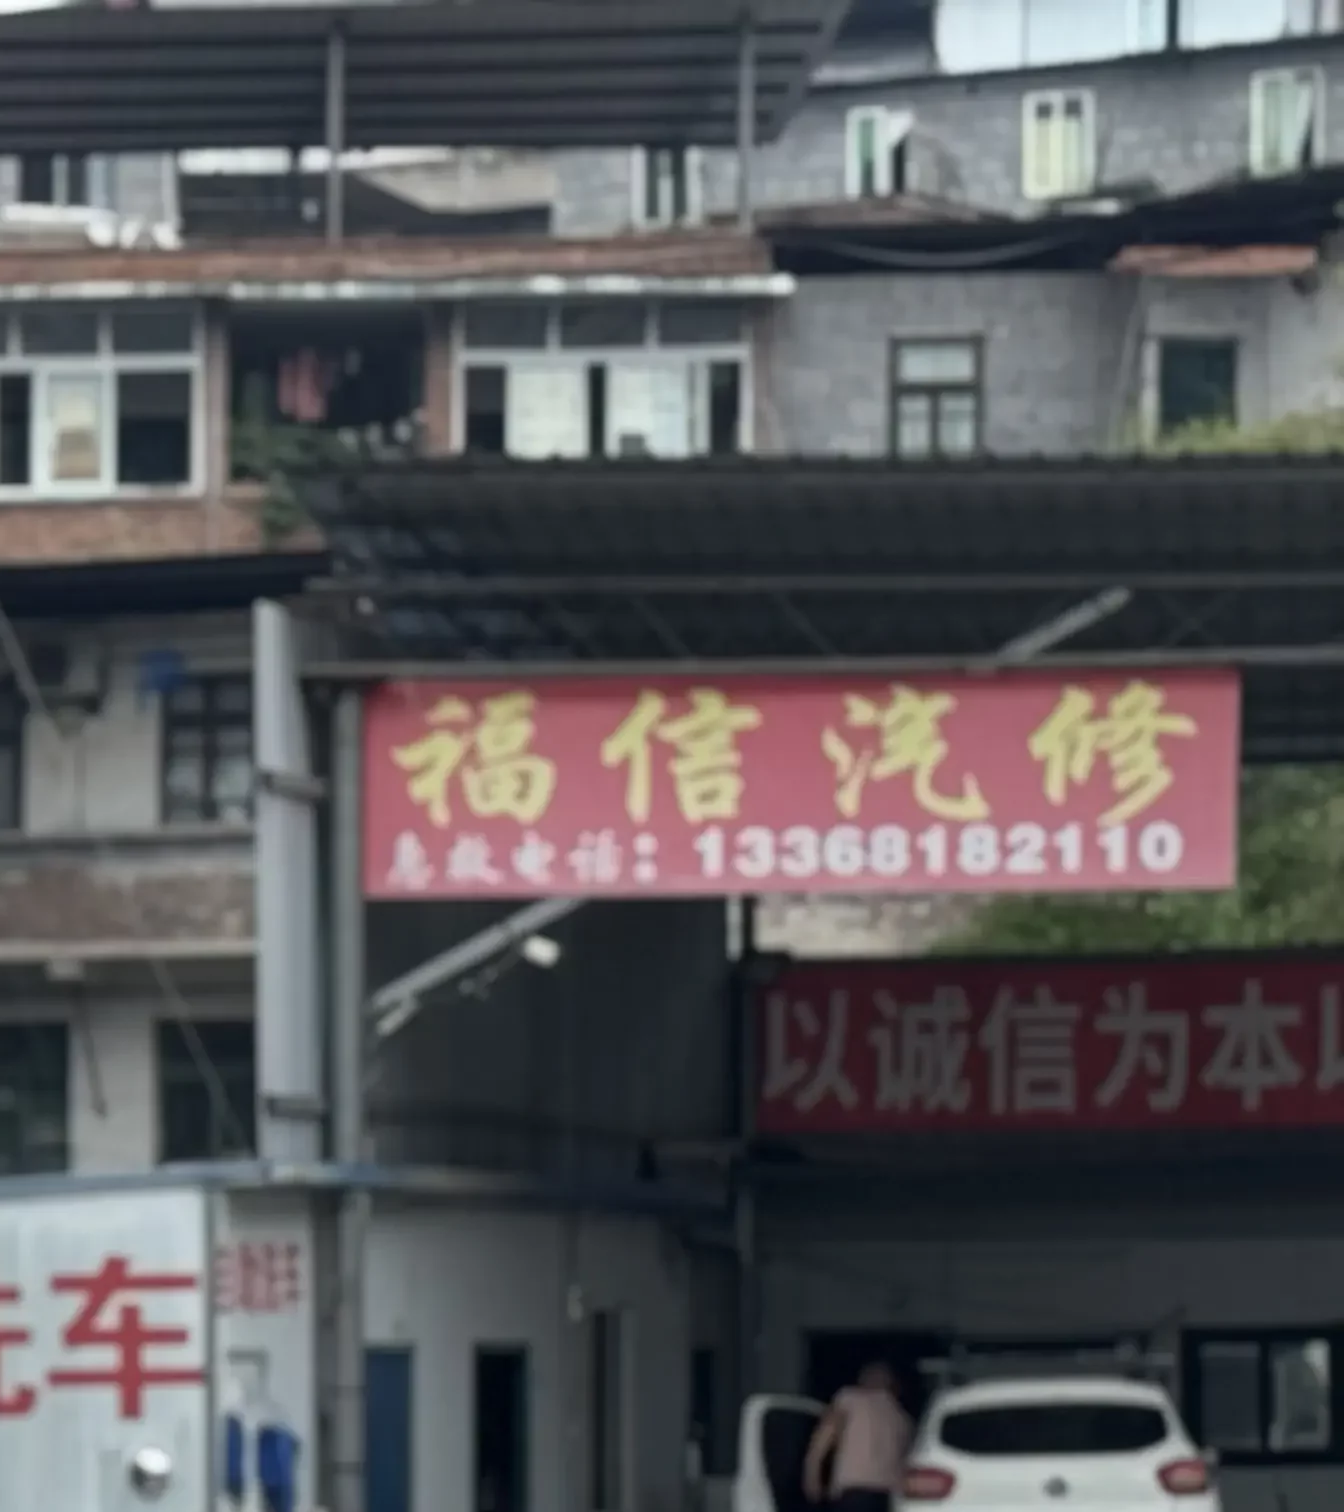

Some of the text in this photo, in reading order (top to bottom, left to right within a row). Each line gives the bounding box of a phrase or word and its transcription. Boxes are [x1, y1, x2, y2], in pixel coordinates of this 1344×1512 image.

[389, 683, 1196, 827] 福信汽修
[693, 822, 1183, 878] 13368182110
